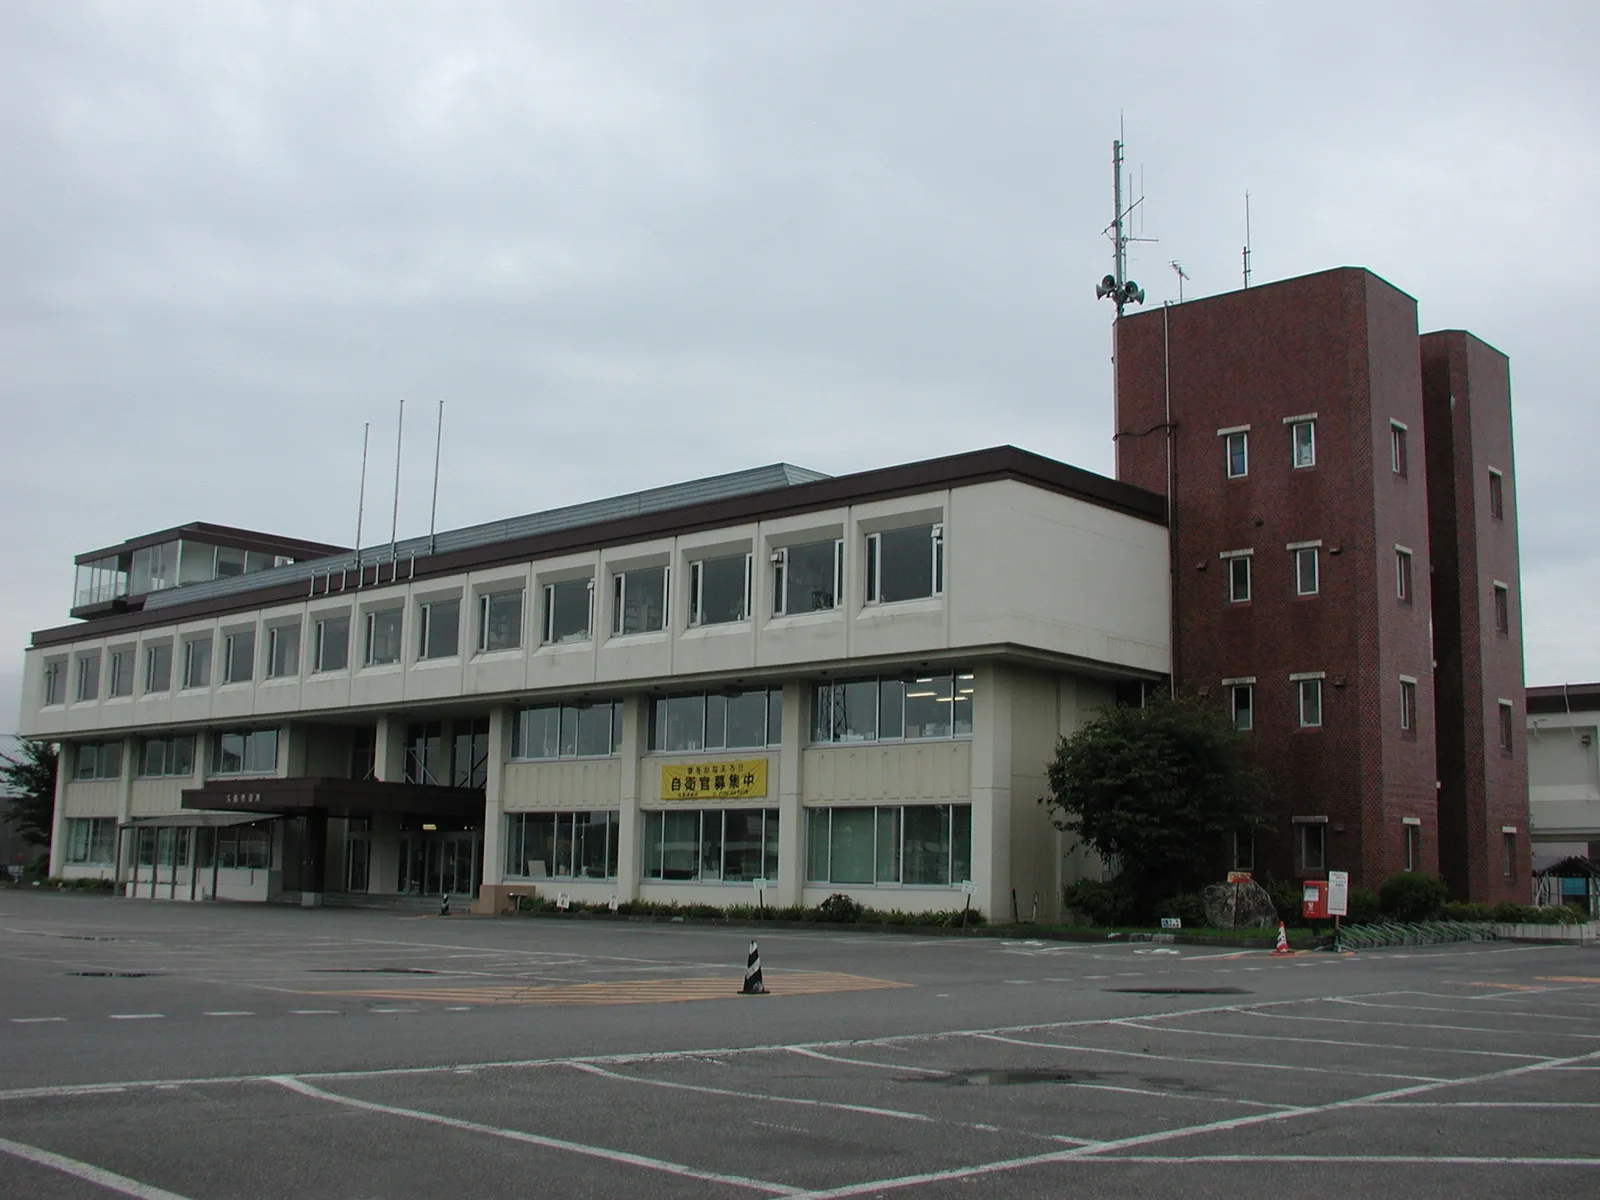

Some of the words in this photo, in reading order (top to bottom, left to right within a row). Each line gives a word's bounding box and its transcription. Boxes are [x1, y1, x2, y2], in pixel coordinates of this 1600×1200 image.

[671, 772, 754, 792] 自衛官募集中
